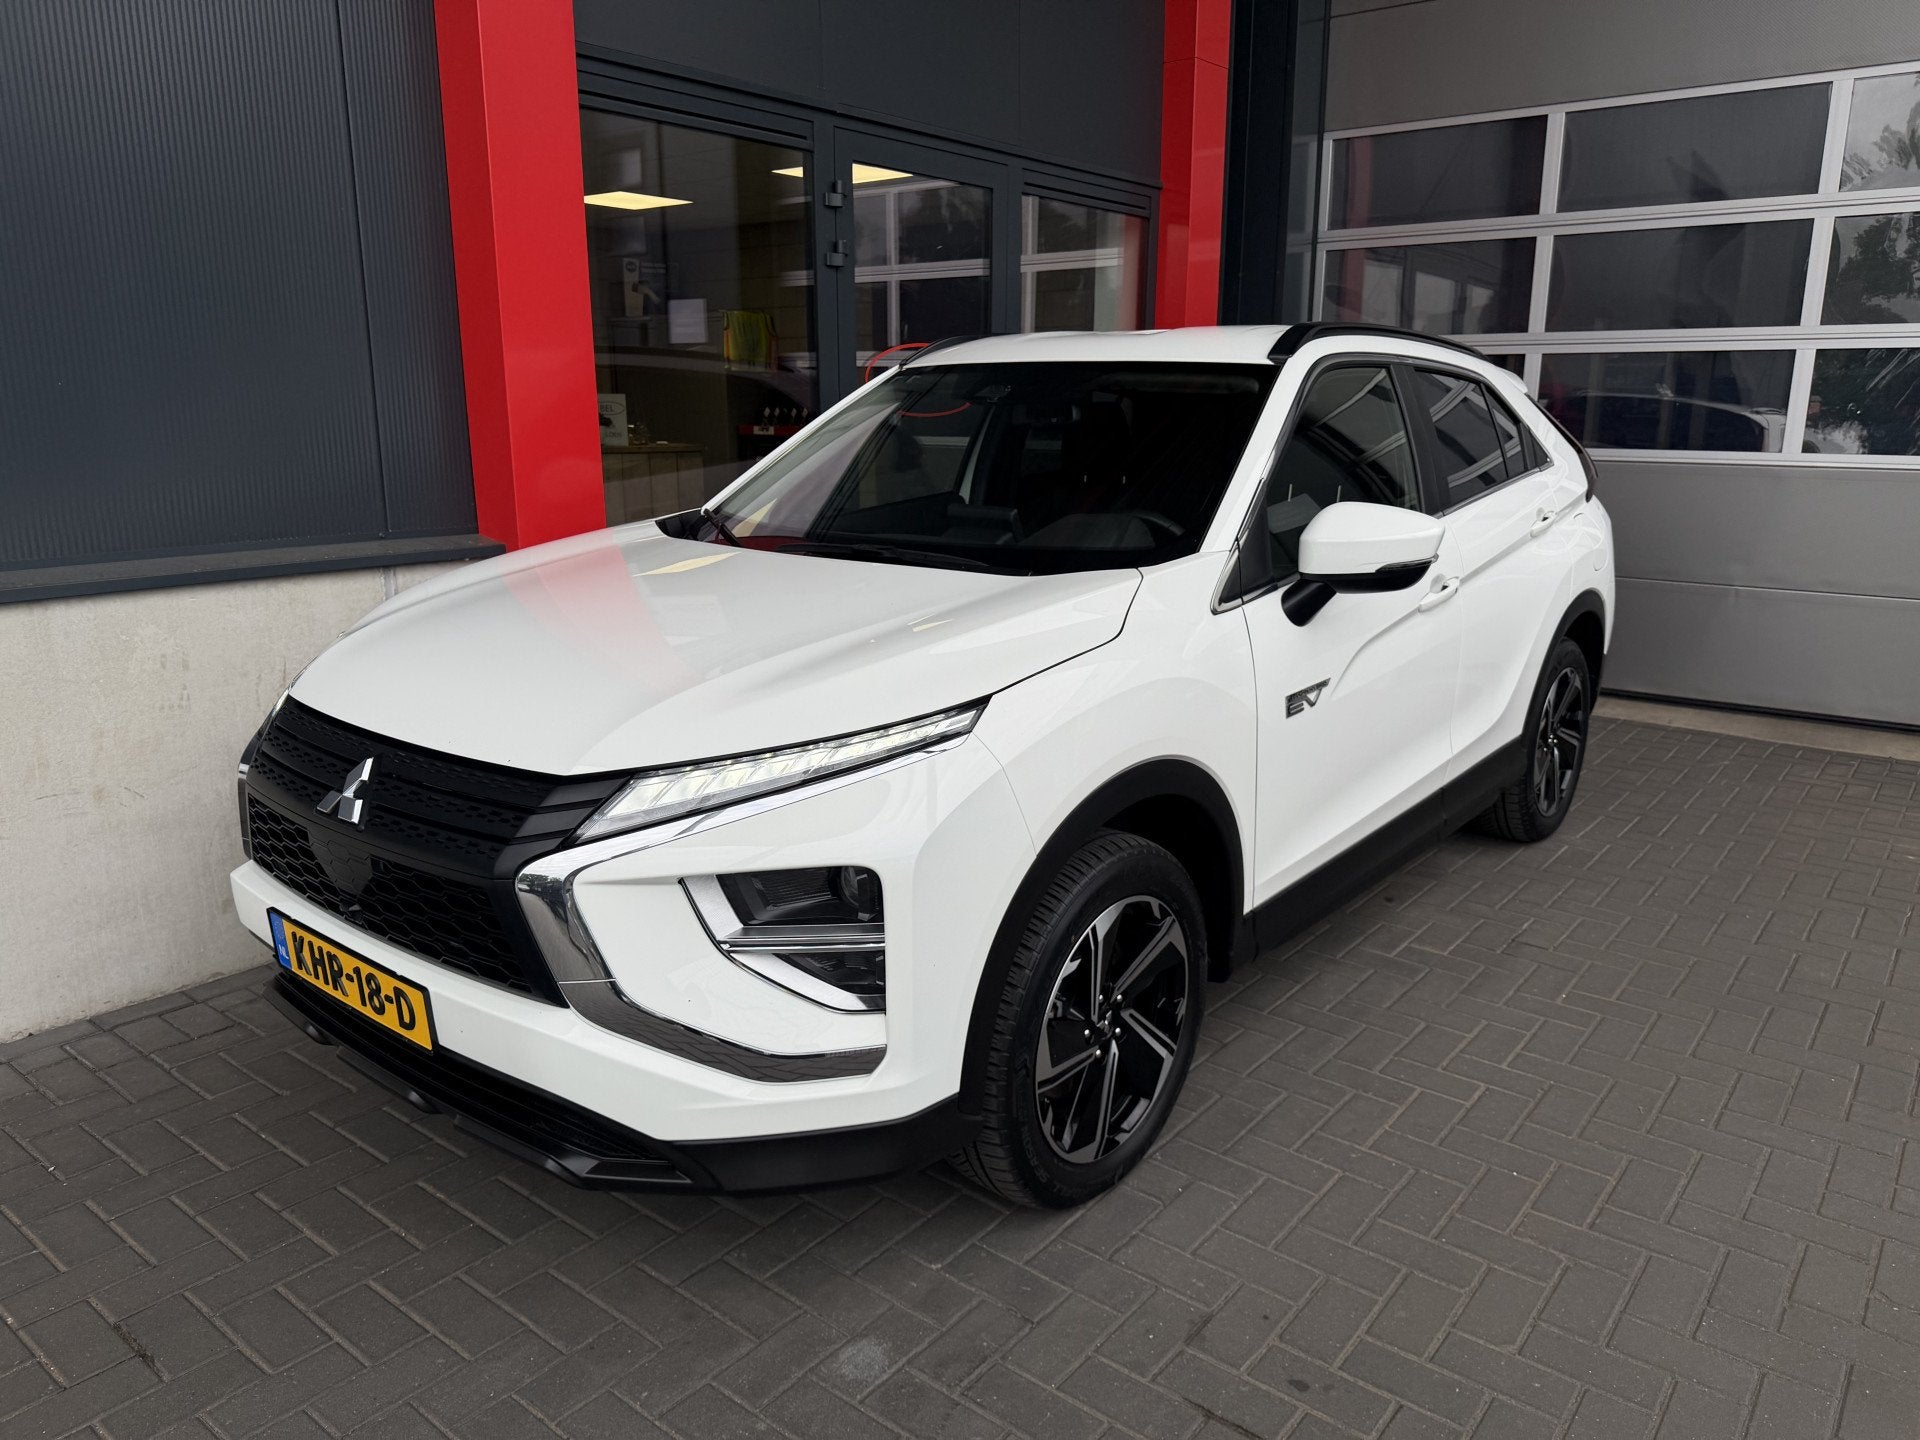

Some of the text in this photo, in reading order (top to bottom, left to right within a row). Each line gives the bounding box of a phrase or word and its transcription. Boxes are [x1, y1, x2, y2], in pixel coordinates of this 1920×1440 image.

[1285, 677, 1331, 719] EV
[278, 944, 289, 959] NL
[291, 931, 416, 1031] KHR-18-D
